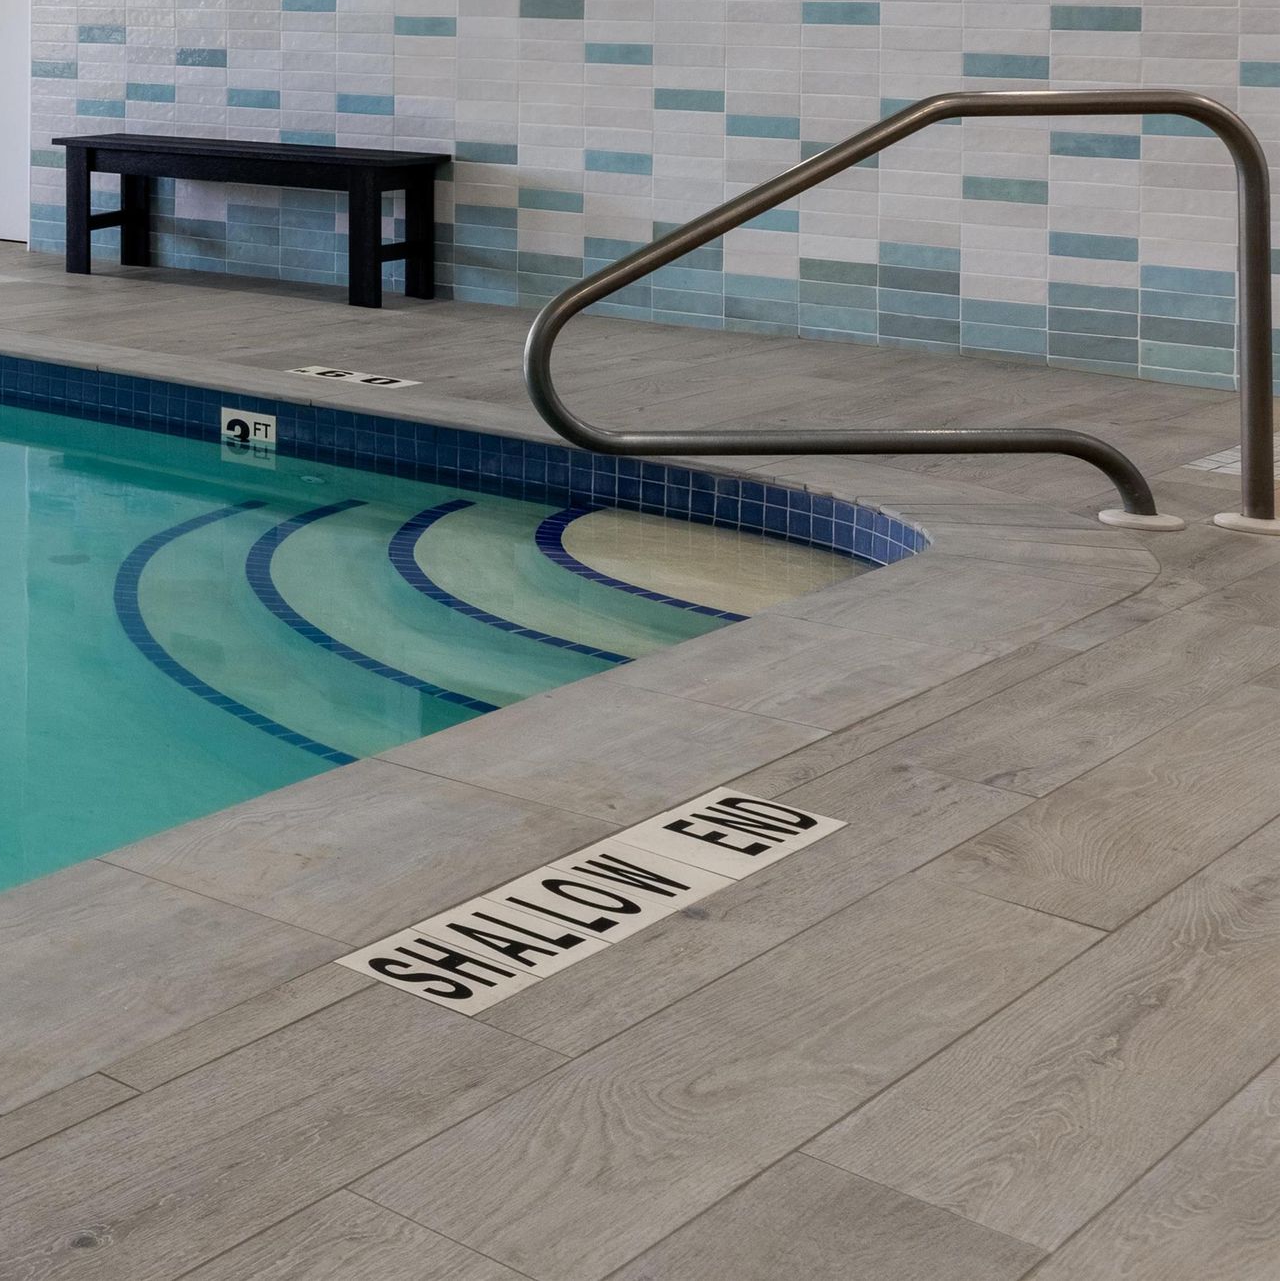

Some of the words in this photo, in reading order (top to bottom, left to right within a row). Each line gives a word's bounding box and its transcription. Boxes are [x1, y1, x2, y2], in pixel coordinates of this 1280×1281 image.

[226, 418, 250, 443] 3
[253, 421, 271, 439] FT
[368, 853, 692, 1000] SHALLOW
[662, 796, 819, 857] END
